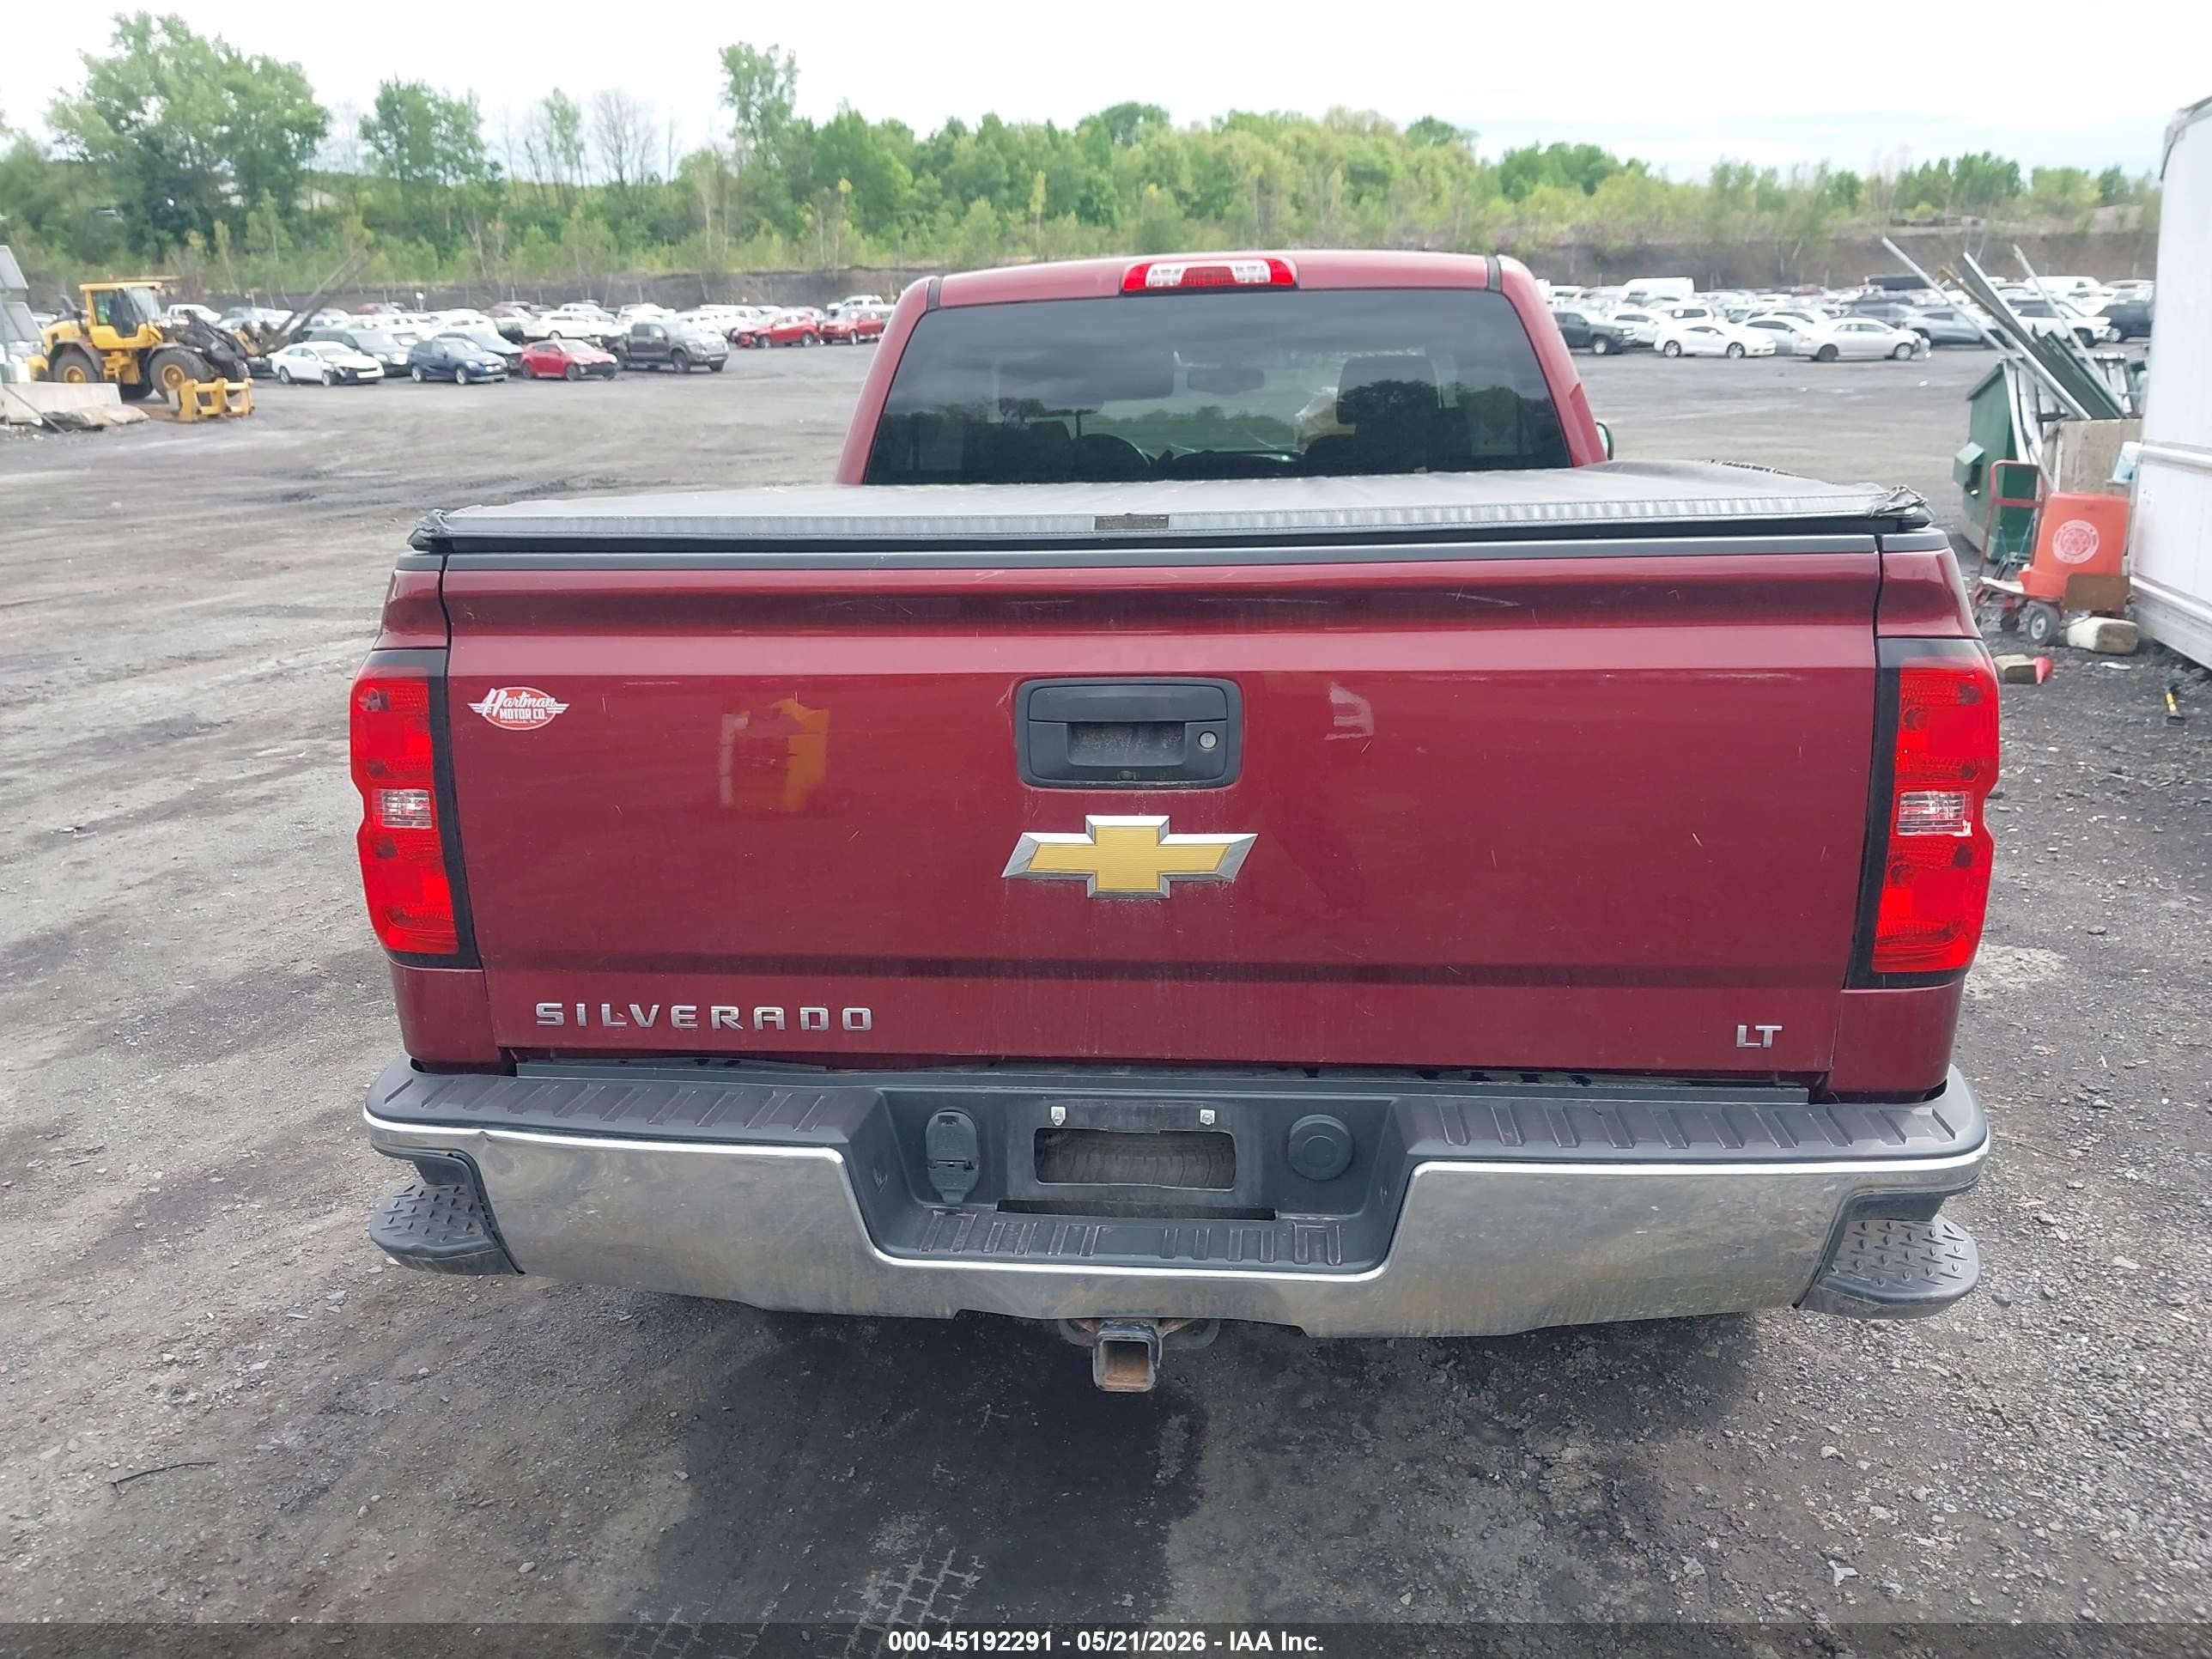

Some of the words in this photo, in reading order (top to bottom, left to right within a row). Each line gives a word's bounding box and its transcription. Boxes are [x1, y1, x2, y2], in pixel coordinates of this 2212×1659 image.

[481, 687, 556, 716] Hartman
[499, 708, 532, 720] MOTOR
[532, 708, 548, 720] CO.
[535, 1002, 873, 1032] SILVERADO
[1736, 1024, 1784, 1048] LT
